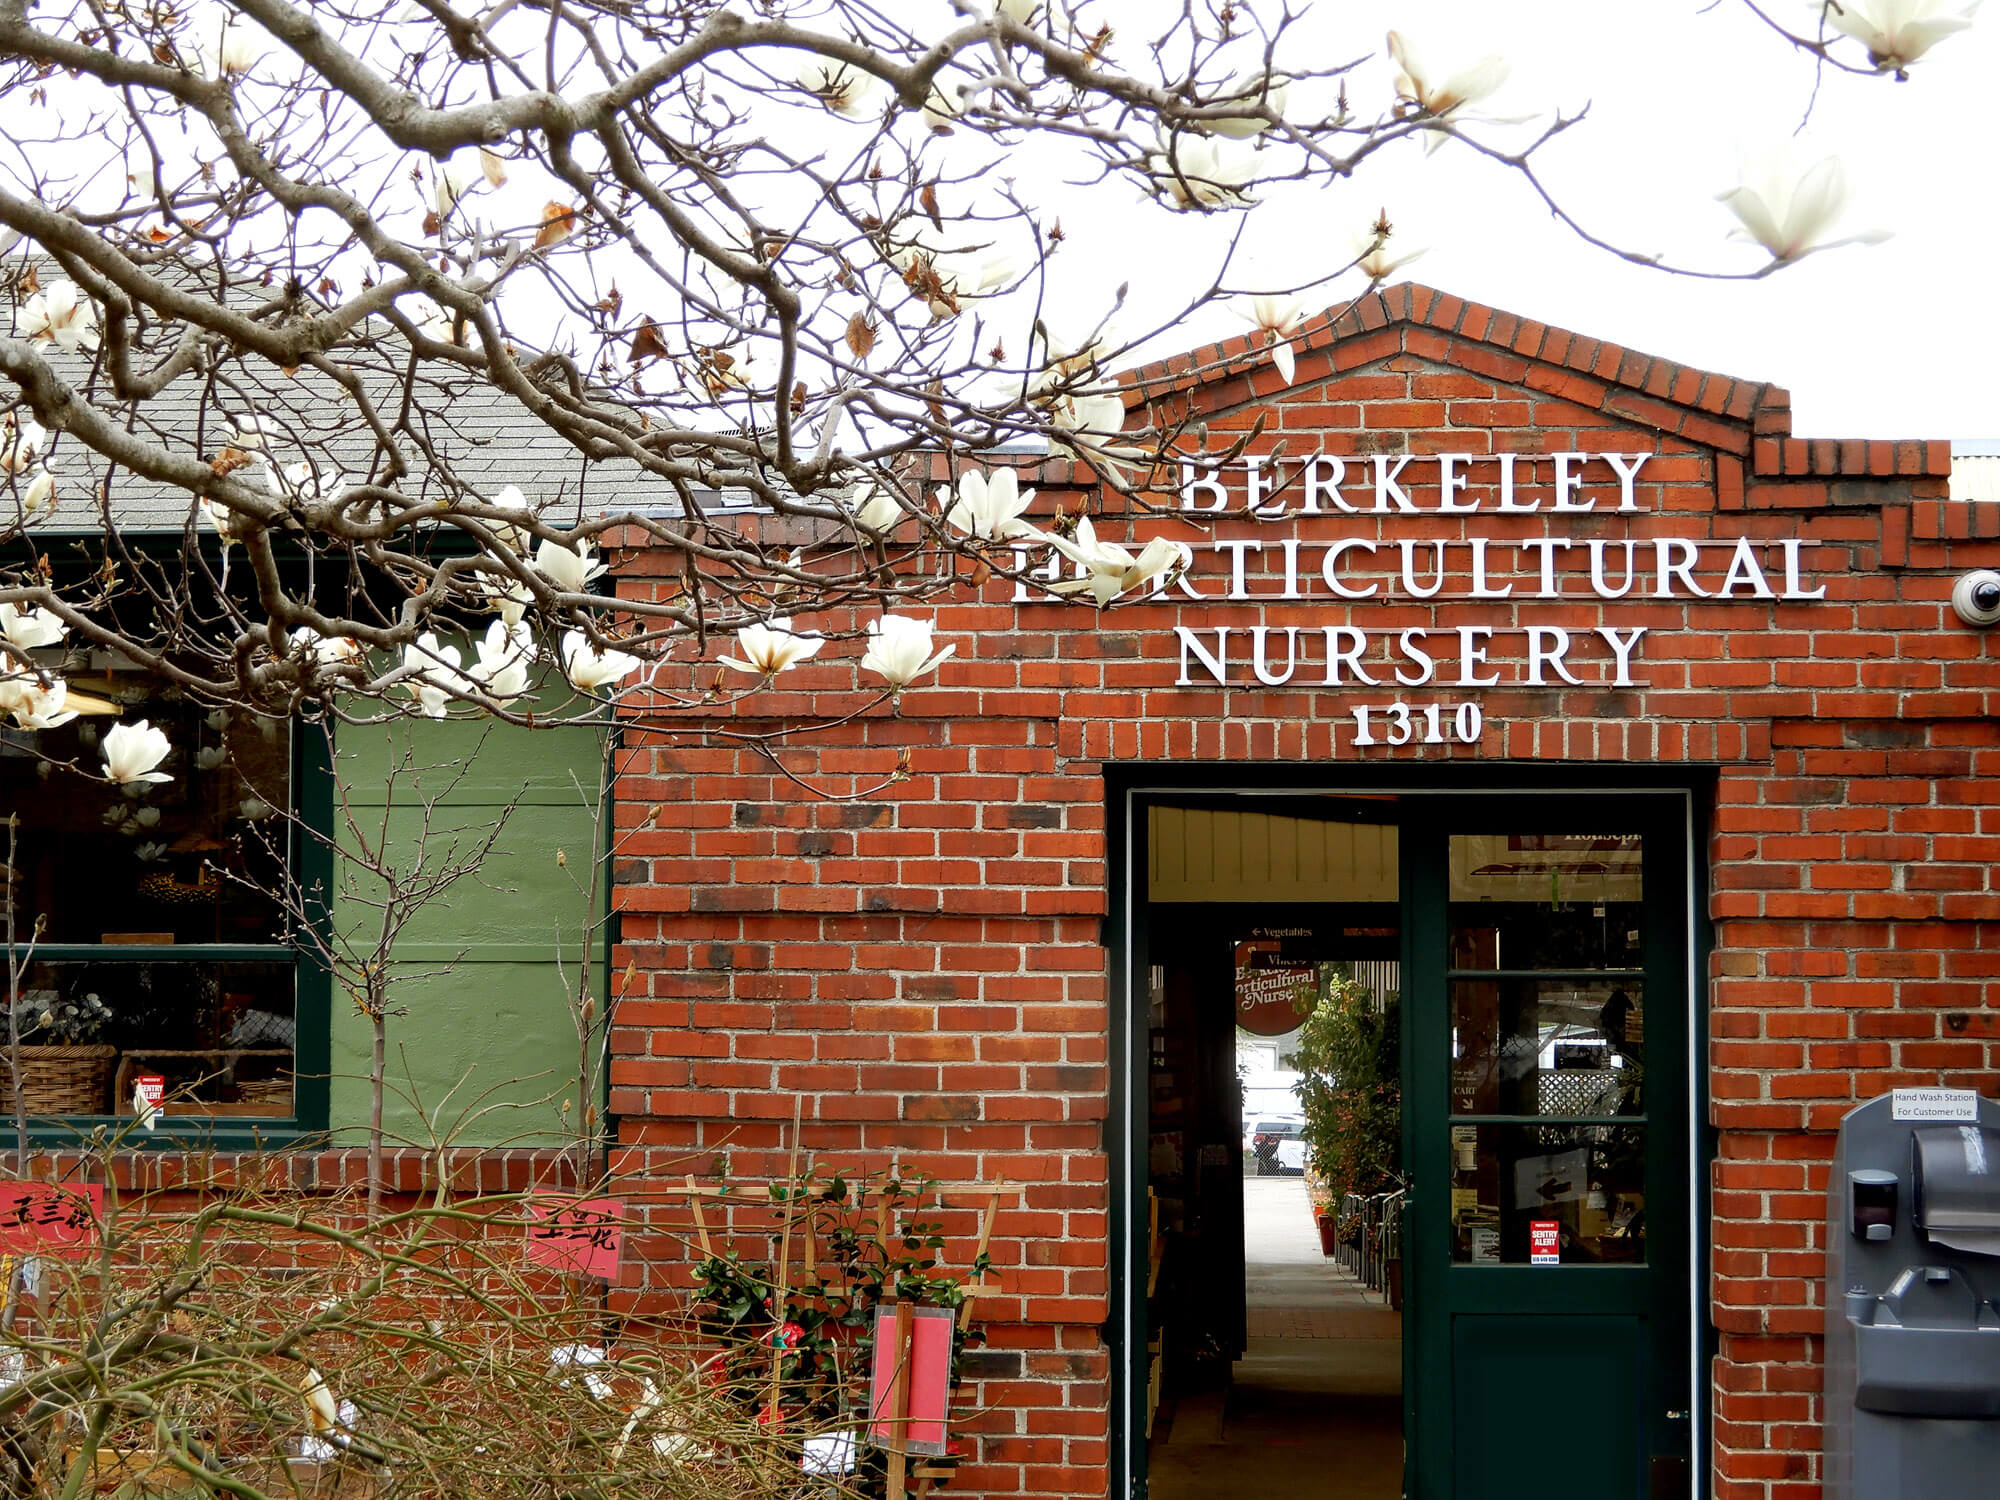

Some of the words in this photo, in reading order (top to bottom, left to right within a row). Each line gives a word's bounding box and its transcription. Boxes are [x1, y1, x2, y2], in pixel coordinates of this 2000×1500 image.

[1179, 452, 1652, 515] BERKELEY
[1011, 536, 1826, 602] HRTICULTURAL
[1173, 626, 1648, 687] NURSERY
[1353, 702, 1483, 746] 1310
[1264, 927, 1312, 937] Vegetables
[1235, 970, 1314, 993] orticultural
[1241, 988, 1294, 1010] Nurse
[1897, 1108, 1911, 1116] For
[1913, 1108, 1953, 1116] Customer
[1956, 1108, 1972, 1116] Use
[1532, 1231, 1558, 1239] SENTRY
[1534, 1239, 1556, 1247] ALERT
